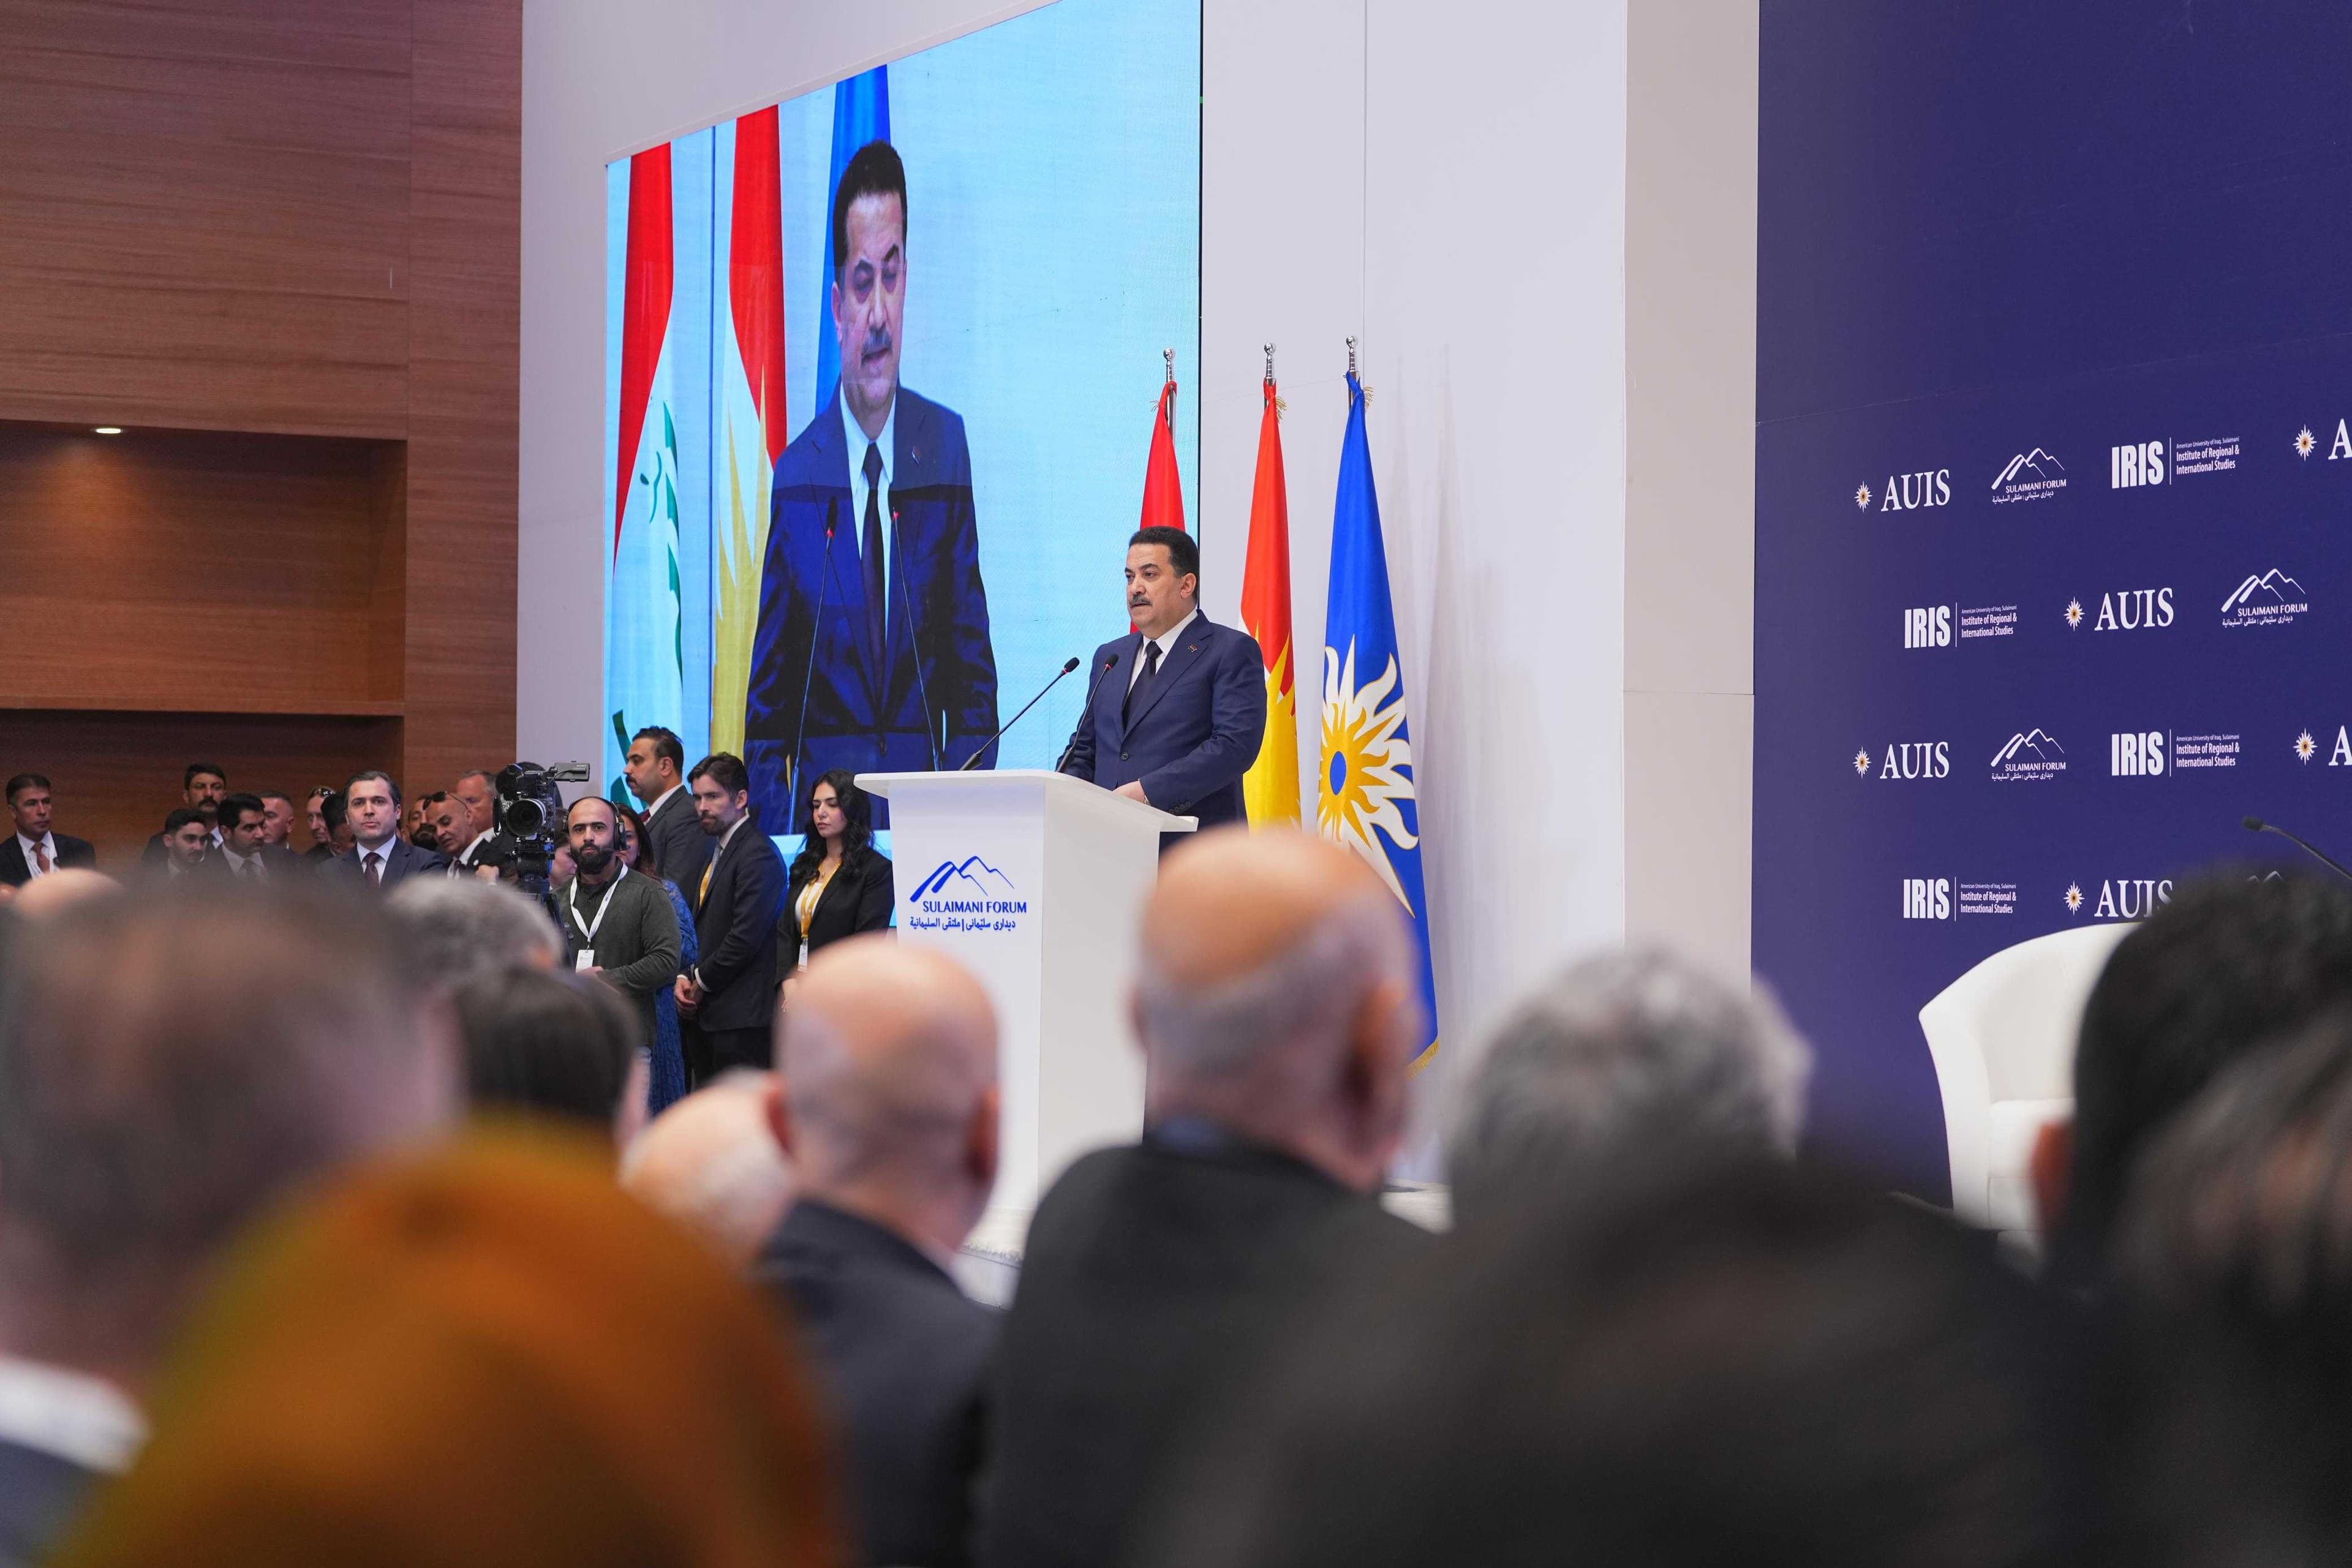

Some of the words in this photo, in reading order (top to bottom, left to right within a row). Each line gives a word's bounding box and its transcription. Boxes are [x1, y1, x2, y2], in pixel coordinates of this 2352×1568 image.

[2176, 450, 2201, 461] Institute
[2201, 448, 2208, 459] of
[2209, 445, 2233, 459] Regional
[2234, 444, 2239, 454] &
[2112, 440, 2164, 489] IRIS
[2176, 460, 2214, 475] International
[2214, 458, 2236, 470] Studies
[1881, 469, 1950, 511] AUIS
[2005, 481, 2041, 494] SULAIMANI
[2043, 478, 2067, 489] FORUM
[2094, 587, 2174, 631] AUIS
[2237, 605, 2278, 617] SULAIMANI
[2280, 603, 2307, 614] FORUM
[1905, 605, 1951, 649] IRIS
[1962, 616, 1983, 626] Institute
[1983, 614, 1989, 624] of
[1989, 612, 2011, 625] Regional
[2013, 612, 2017, 622] &
[1962, 626, 1994, 638] International
[1994, 625, 2013, 636] Studies
[2112, 731, 2164, 776] IRIS
[2176, 744, 2201, 755] Institute
[2201, 742, 2208, 754] of
[2209, 742, 2233, 756] Regional
[2234, 742, 2239, 753] &
[1880, 741, 1949, 778] AUIS
[2005, 763, 2041, 772] SULAIMANI
[2042, 762, 2066, 771] FORUM
[2176, 756, 2214, 767] International
[2214, 755, 2236, 766] Studies
[1904, 878, 1950, 919] IRIS
[1961, 891, 1982, 901] Institute
[1983, 891, 1989, 901] of
[1989, 891, 2011, 903] Regional
[2012, 891, 2016, 901] &
[922, 901, 982, 913] SULAIMANI
[986, 902, 1027, 913] FORUM
[1961, 903, 1993, 913] International
[1994, 903, 2013, 913] Studies
